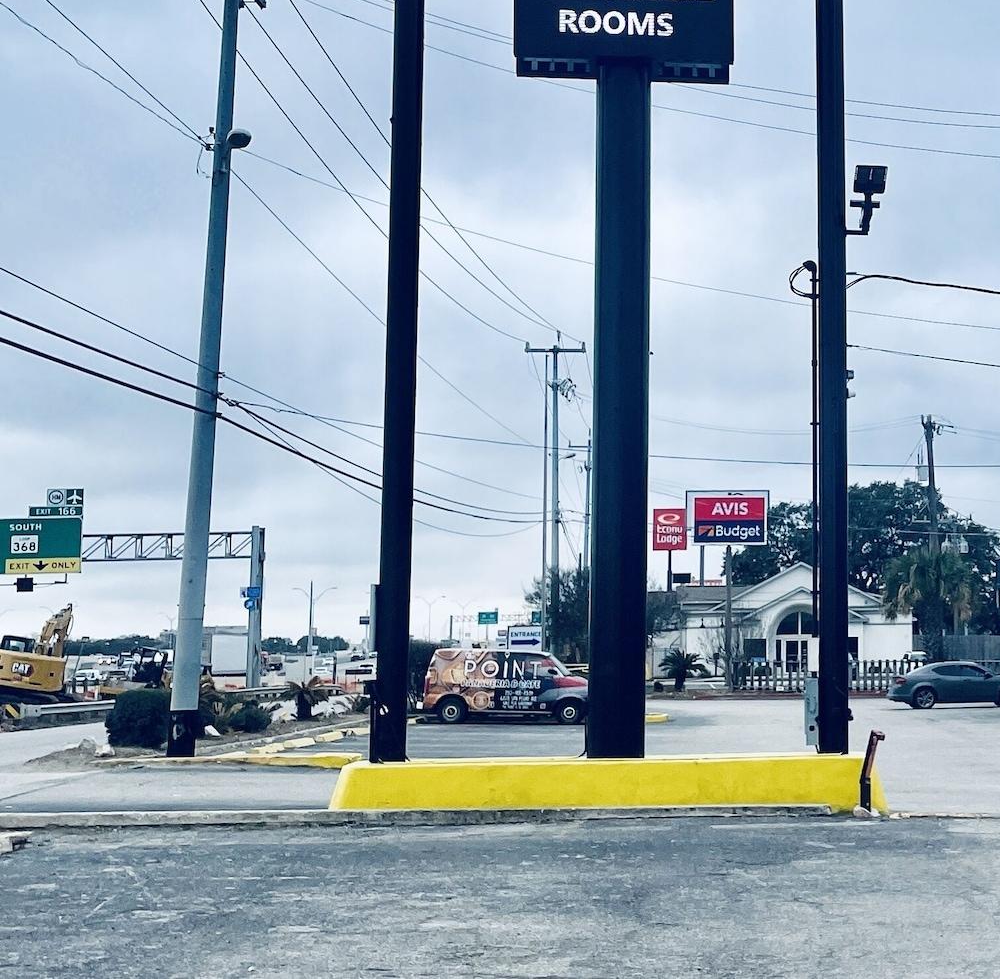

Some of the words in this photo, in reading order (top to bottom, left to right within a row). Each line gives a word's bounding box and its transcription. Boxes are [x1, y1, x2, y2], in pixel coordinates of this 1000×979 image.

[558, 8, 674, 37] ROOMS
[58, 507, 76, 515] 166
[711, 502, 750, 516] AVIS
[9, 523, 42, 531] SOUTH
[715, 524, 761, 540] Budget
[656, 533, 683, 545] Lodge
[13, 542, 36, 552] 368
[9, 562, 30, 570] EXIT
[12, 662, 31, 674] CAT
[464, 659, 542, 680] POINT
